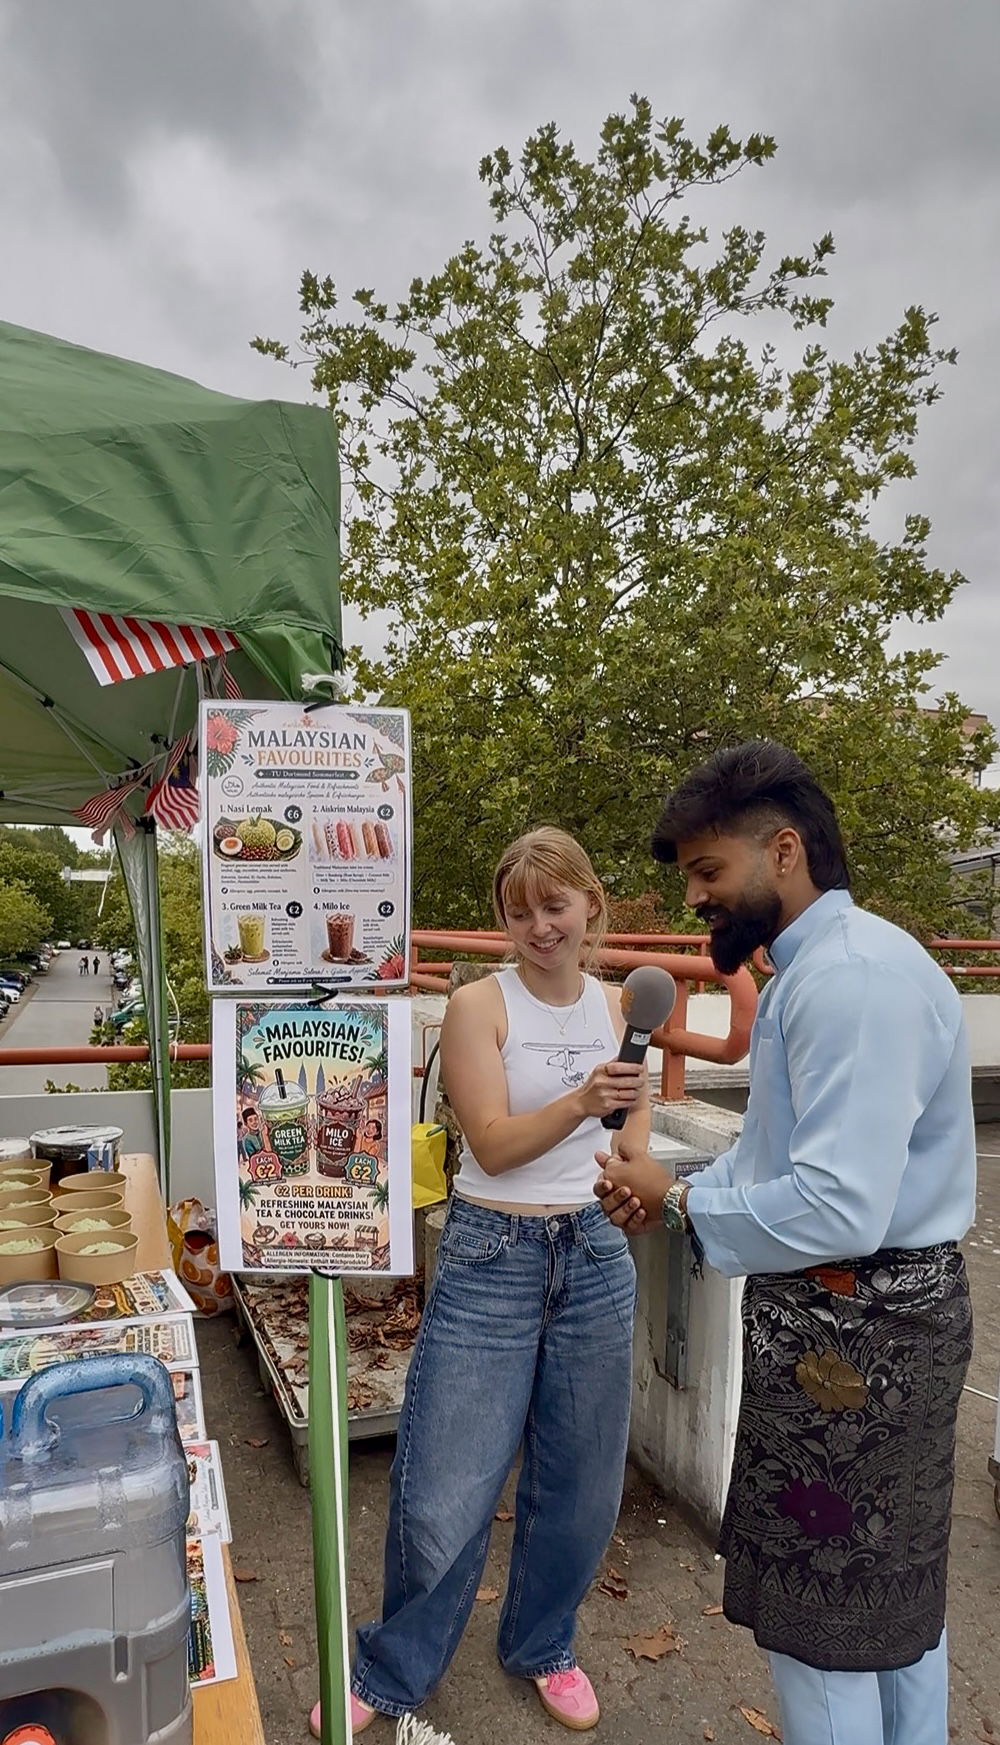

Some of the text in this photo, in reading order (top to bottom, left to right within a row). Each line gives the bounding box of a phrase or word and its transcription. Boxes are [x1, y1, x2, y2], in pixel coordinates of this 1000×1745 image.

[248, 730, 366, 750] MALAYSIAN
[257, 750, 361, 767] FAVOURITES
[283, 770, 311, 778] Dortmund
[247, 805, 273, 813] Lemak
[320, 805, 346, 813] Aiskrim
[347, 805, 375, 815] Malaysia
[287, 810, 299, 819] €6
[230, 902, 251, 910] Green
[252, 902, 267, 910] Milk
[269, 902, 281, 910] Tea
[322, 902, 338, 910] Milo
[340, 902, 350, 910] Ice
[266, 1020, 361, 1042] MALAYSIAN
[263, 1040, 365, 1063] FAVOURITES!
[275, 1128, 302, 1139] GREEN
[325, 1127, 349, 1138] MILO
[274, 1138, 291, 1146] MILK
[329, 1138, 343, 1147] ICE
[256, 1164, 276, 1178] €2
[351, 1164, 372, 1180] €2
[274, 1185, 353, 1198] €2 PER DRINK!
[260, 1200, 368, 1210] REFRESHING MALAYSIAN
[256, 1210, 374, 1219] TEA & CHOCOLATE DRINKS!
[280, 1221, 350, 1229] GET YOURS NOW!
